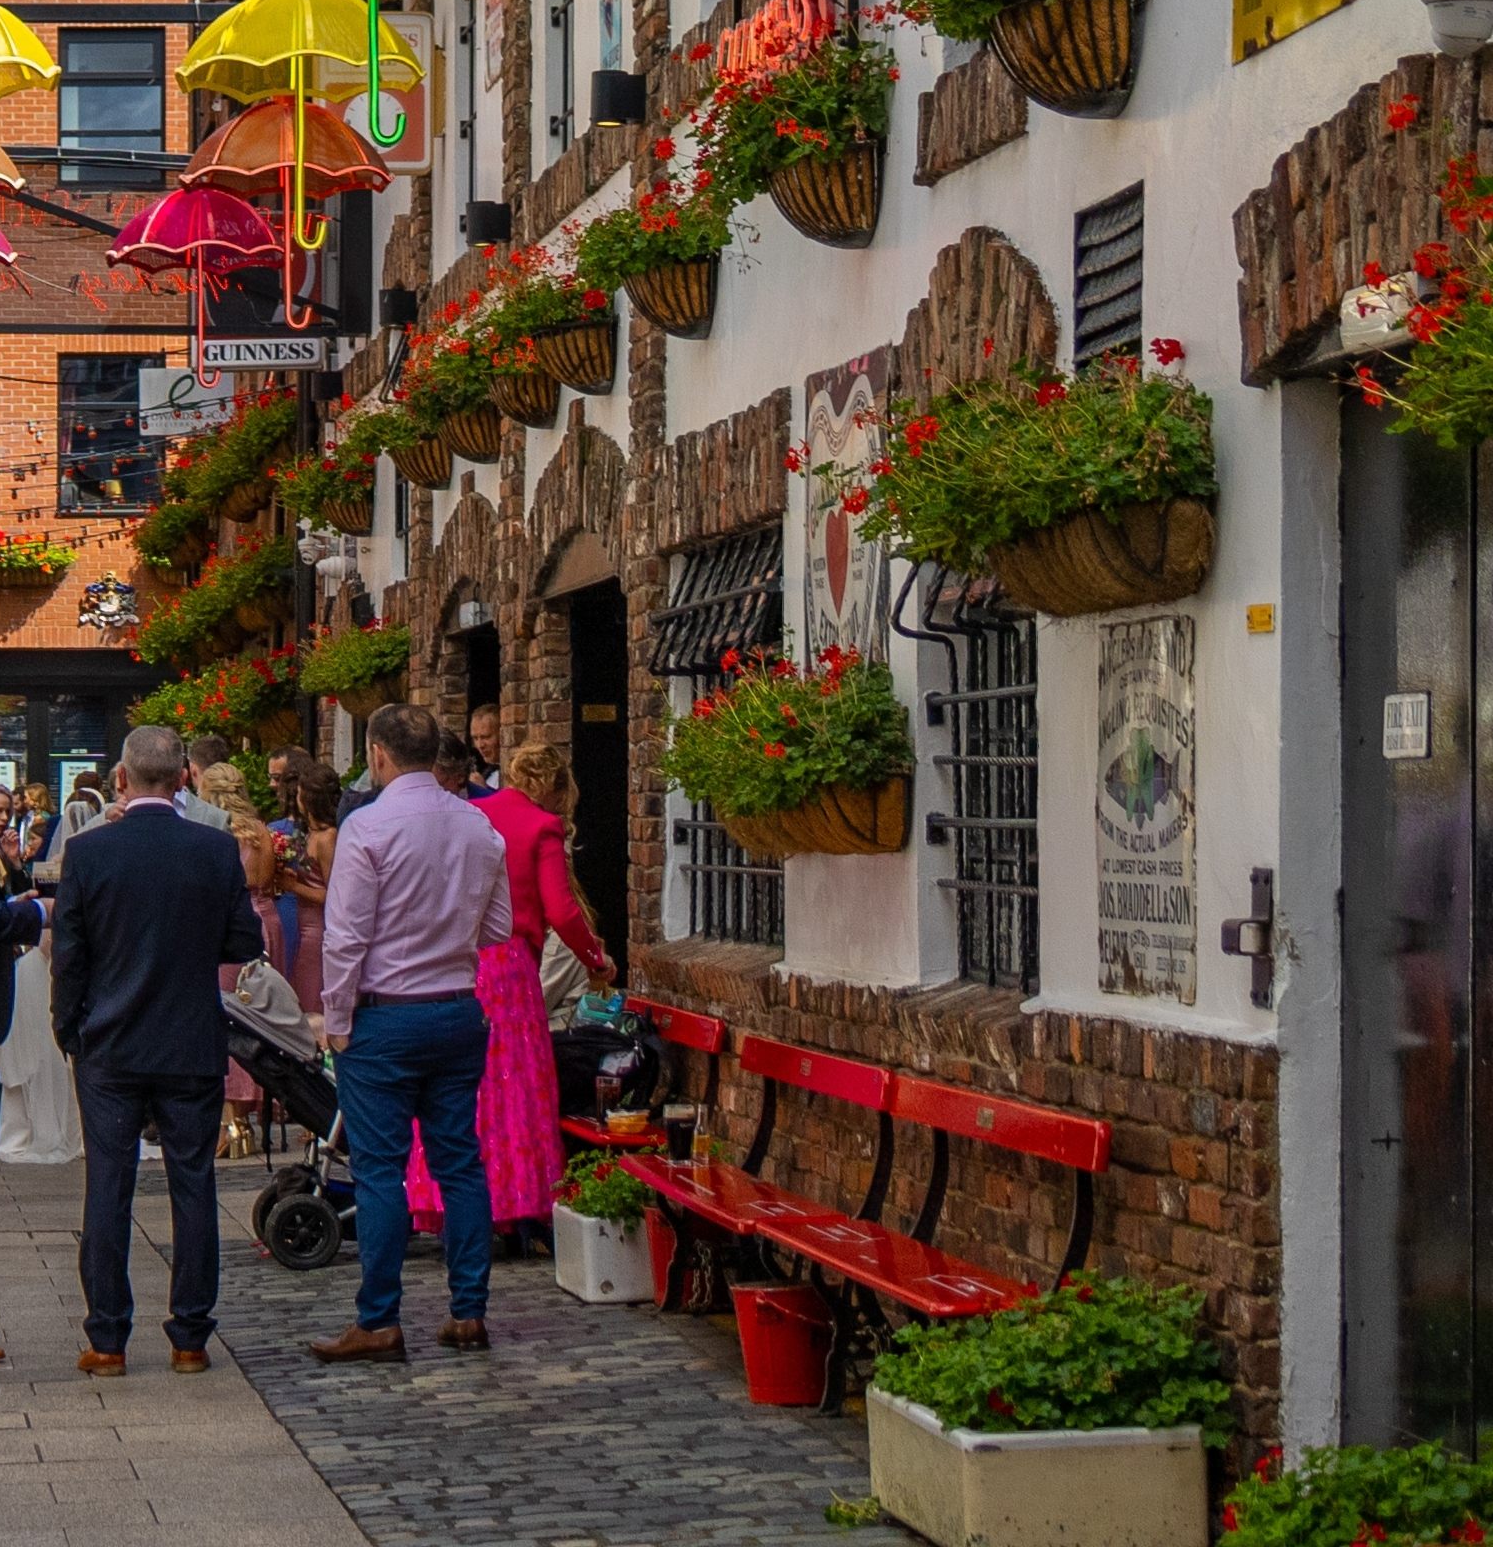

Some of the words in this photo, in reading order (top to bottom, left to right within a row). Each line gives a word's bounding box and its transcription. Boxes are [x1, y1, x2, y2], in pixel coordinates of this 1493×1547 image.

[203, 339, 316, 364] GUINNESS
[1132, 690, 1189, 750] REQUISITES
[1386, 700, 1403, 729] FIRE
[1116, 824, 1128, 852] THE
[1130, 832, 1156, 854] ACTUAL
[1158, 814, 1189, 850] MAKERS
[1102, 858, 1111, 873] AT
[1113, 858, 1137, 875] LOWEST
[1138, 858, 1157, 876] CASH
[1159, 860, 1183, 877] PRICES
[1117, 881, 1164, 924] BRADDELL
